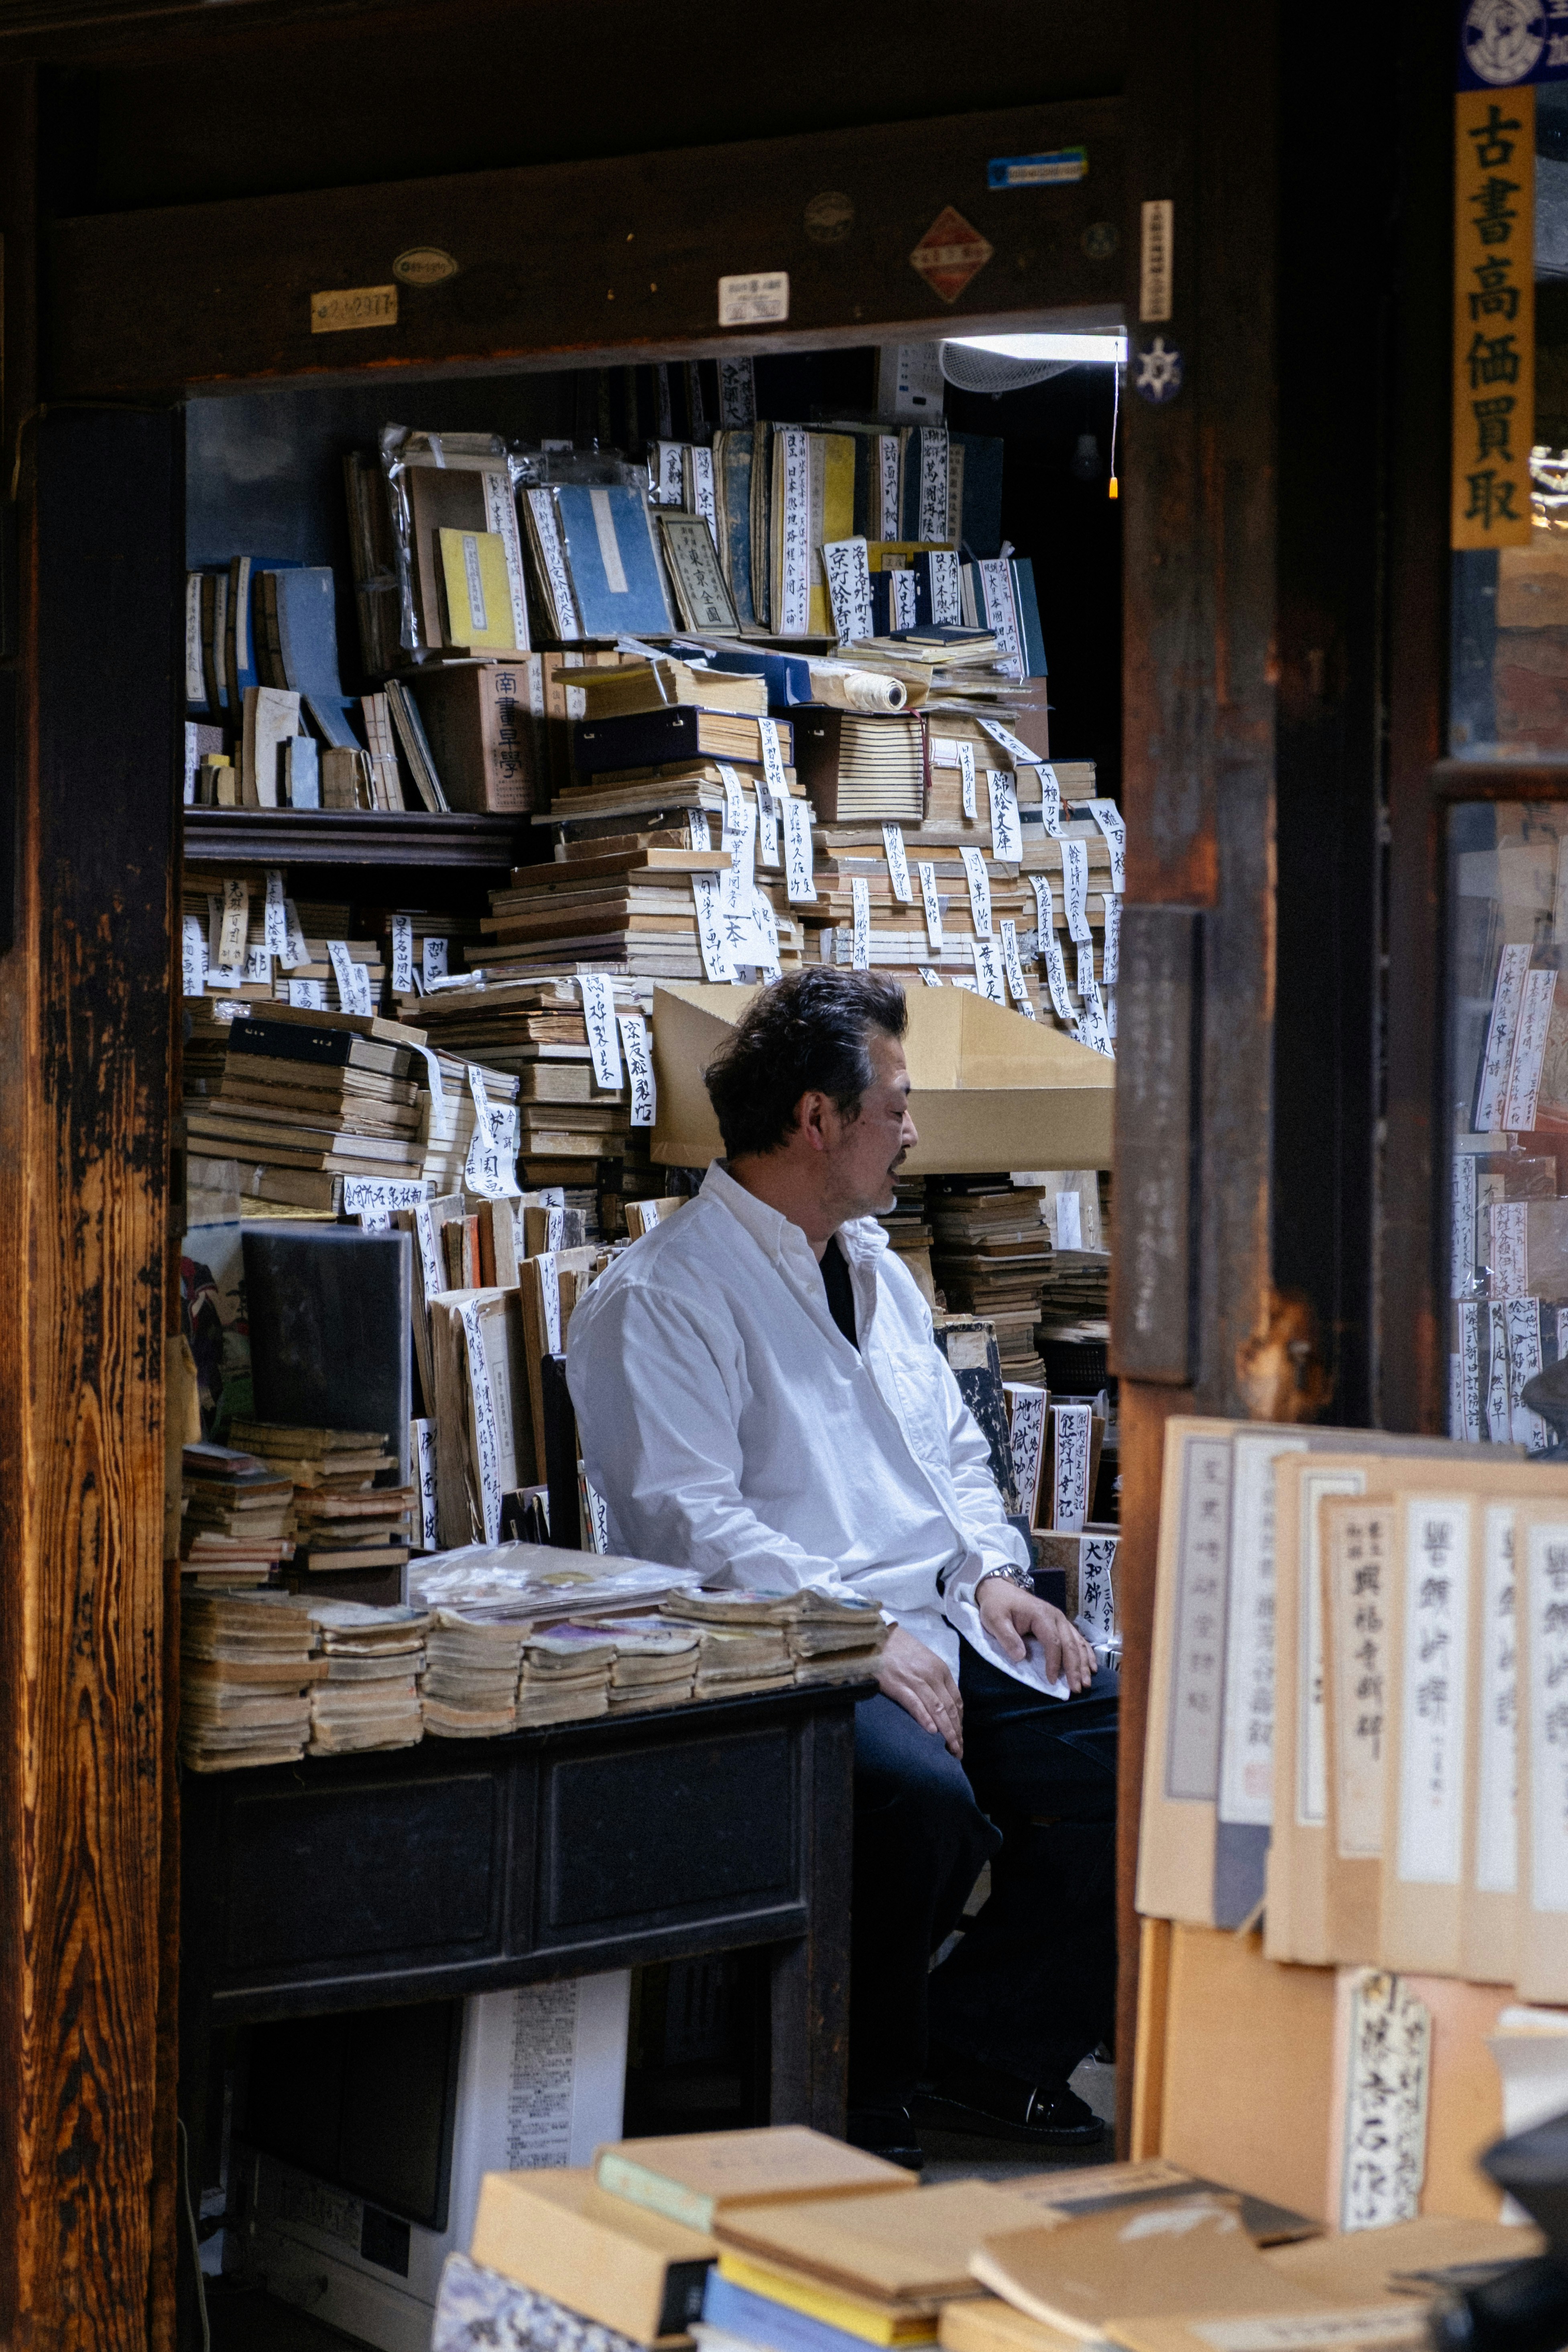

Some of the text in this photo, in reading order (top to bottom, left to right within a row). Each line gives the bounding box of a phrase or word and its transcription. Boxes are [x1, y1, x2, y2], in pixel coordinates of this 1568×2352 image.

[1464, 104, 1522, 531] 古書高価買取
[852, 545, 869, 639] 洛中洛外町々小
[992, 772, 1014, 855] 錦絵文庫
[394, 918, 411, 988] 日本名山図会
[1084, 1541, 1103, 1611] 大和錦
